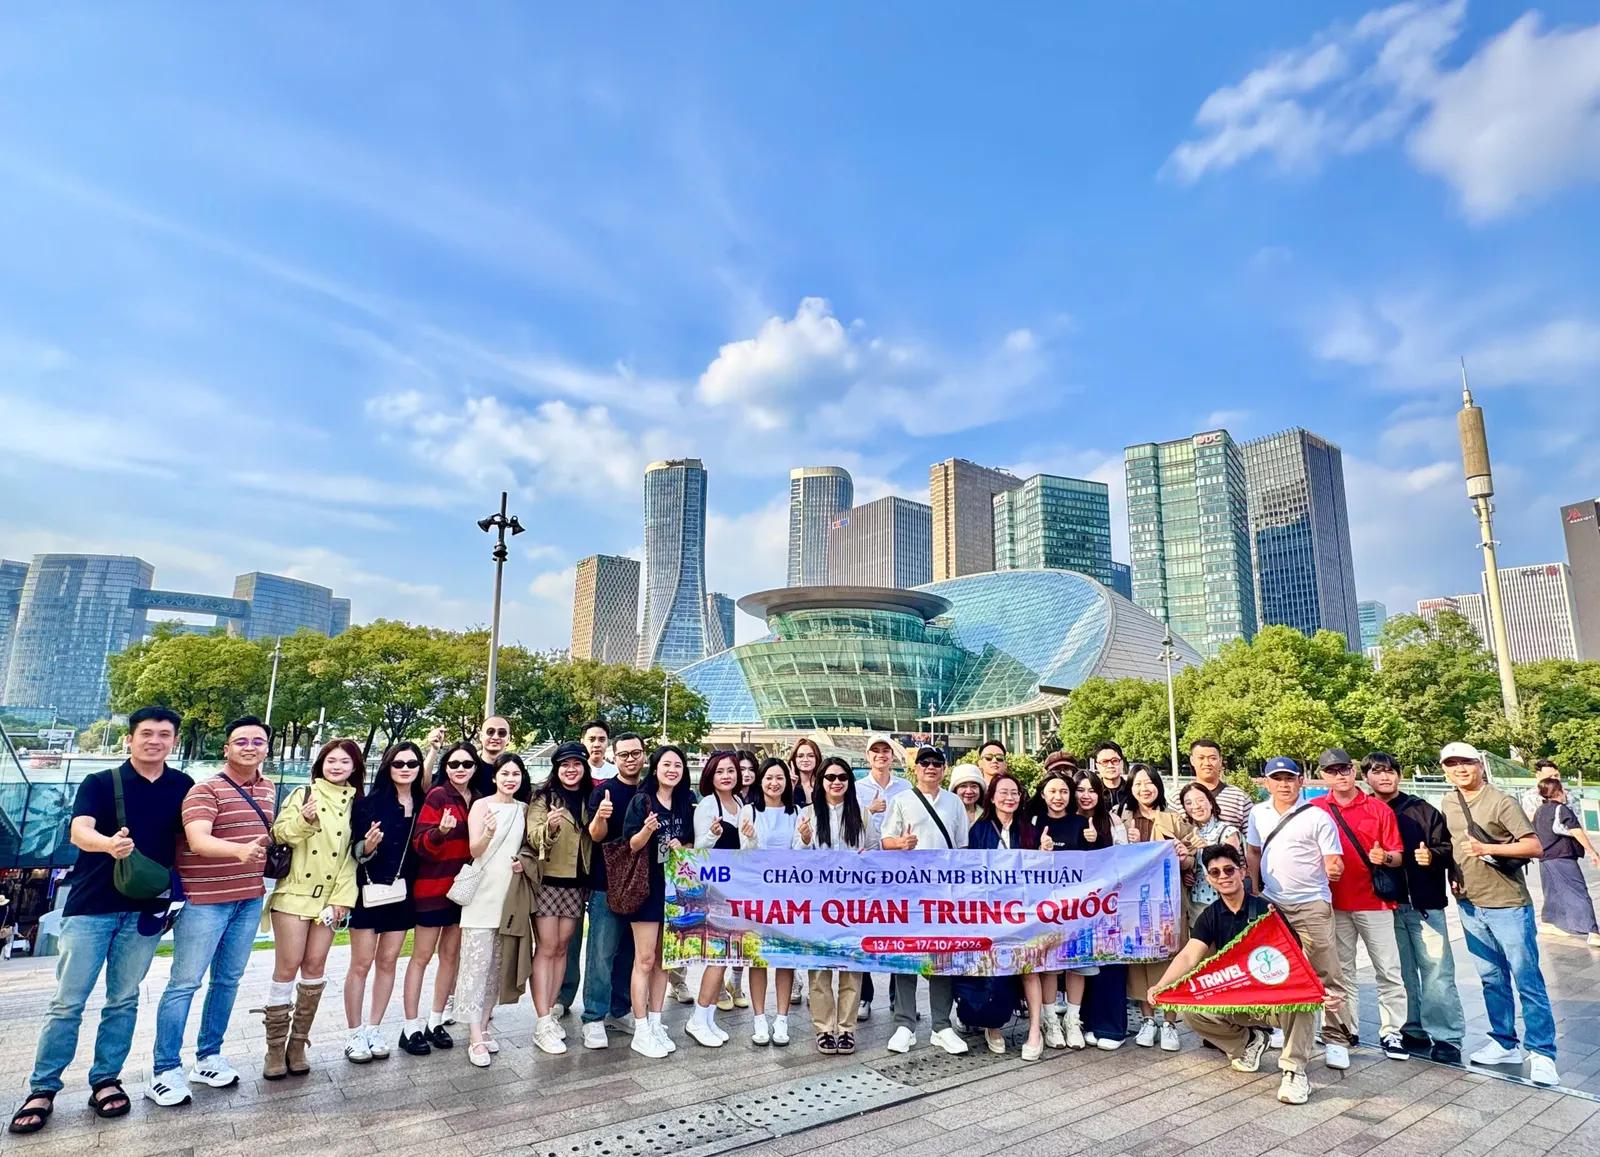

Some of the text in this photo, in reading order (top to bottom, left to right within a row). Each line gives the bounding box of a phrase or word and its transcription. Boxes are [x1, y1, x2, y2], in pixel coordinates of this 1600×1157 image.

[700, 866, 731, 882] MB
[763, 865, 1083, 887] CHÀO MỪNG ĐOÀN MB BÌNH THUẬN
[726, 888, 1119, 927] THAM QUAN TRUNG QUỐC
[1189, 978, 1197, 993] J
[1196, 964, 1247, 990] TRAVEL
